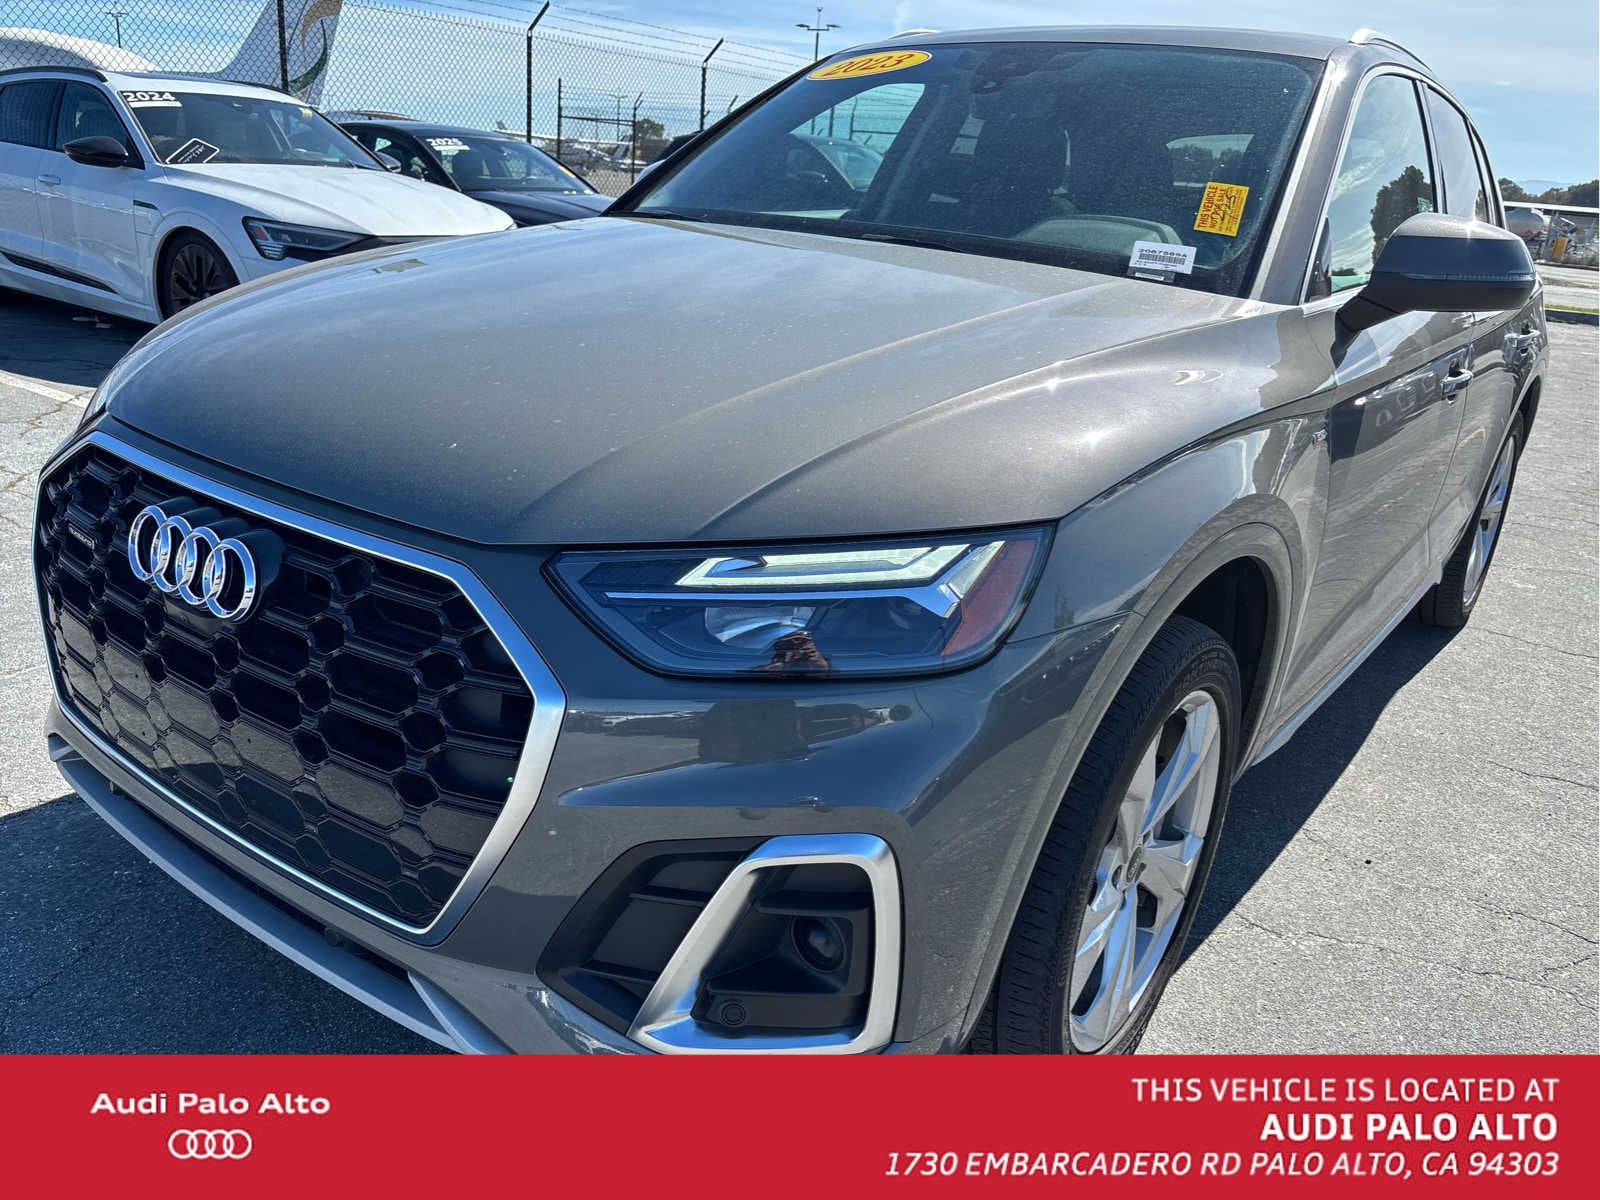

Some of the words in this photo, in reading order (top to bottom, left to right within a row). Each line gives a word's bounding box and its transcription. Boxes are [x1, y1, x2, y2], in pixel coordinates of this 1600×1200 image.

[821, 53, 915, 76] 2023
[122, 91, 176, 101] 2024
[1202, 184, 1218, 212] VEHICLE
[1197, 213, 1210, 229] THIS
